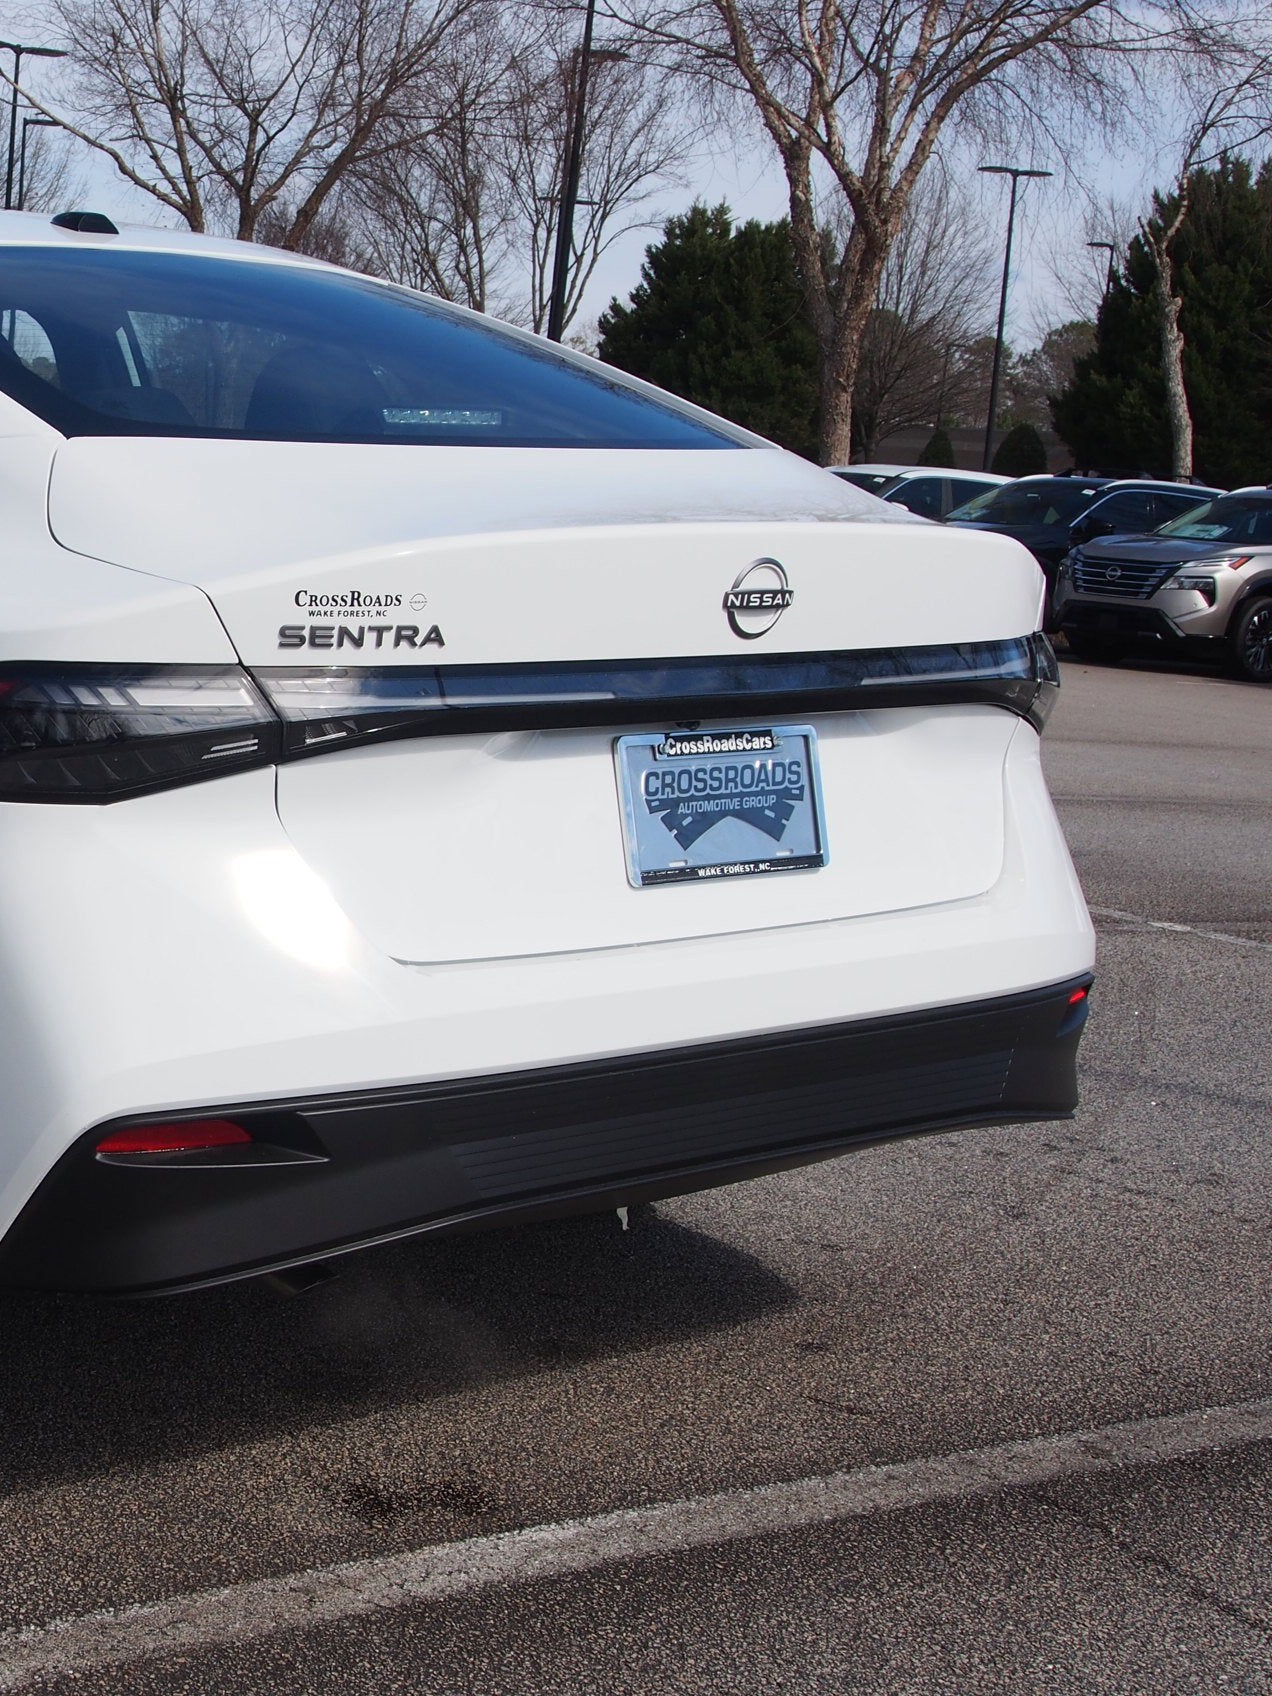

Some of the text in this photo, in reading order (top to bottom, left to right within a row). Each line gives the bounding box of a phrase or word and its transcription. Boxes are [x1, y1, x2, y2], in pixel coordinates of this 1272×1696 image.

[728, 593, 793, 606] NISSAN
[338, 610, 373, 618] FOREST,
[278, 624, 445, 649] SENTRA
[667, 733, 773, 755] CrossRoadsCars
[643, 760, 802, 798] CROSSROADS
[678, 795, 777, 814] AUTOMOTIVE GROUP
[697, 867, 722, 877] WAKE
